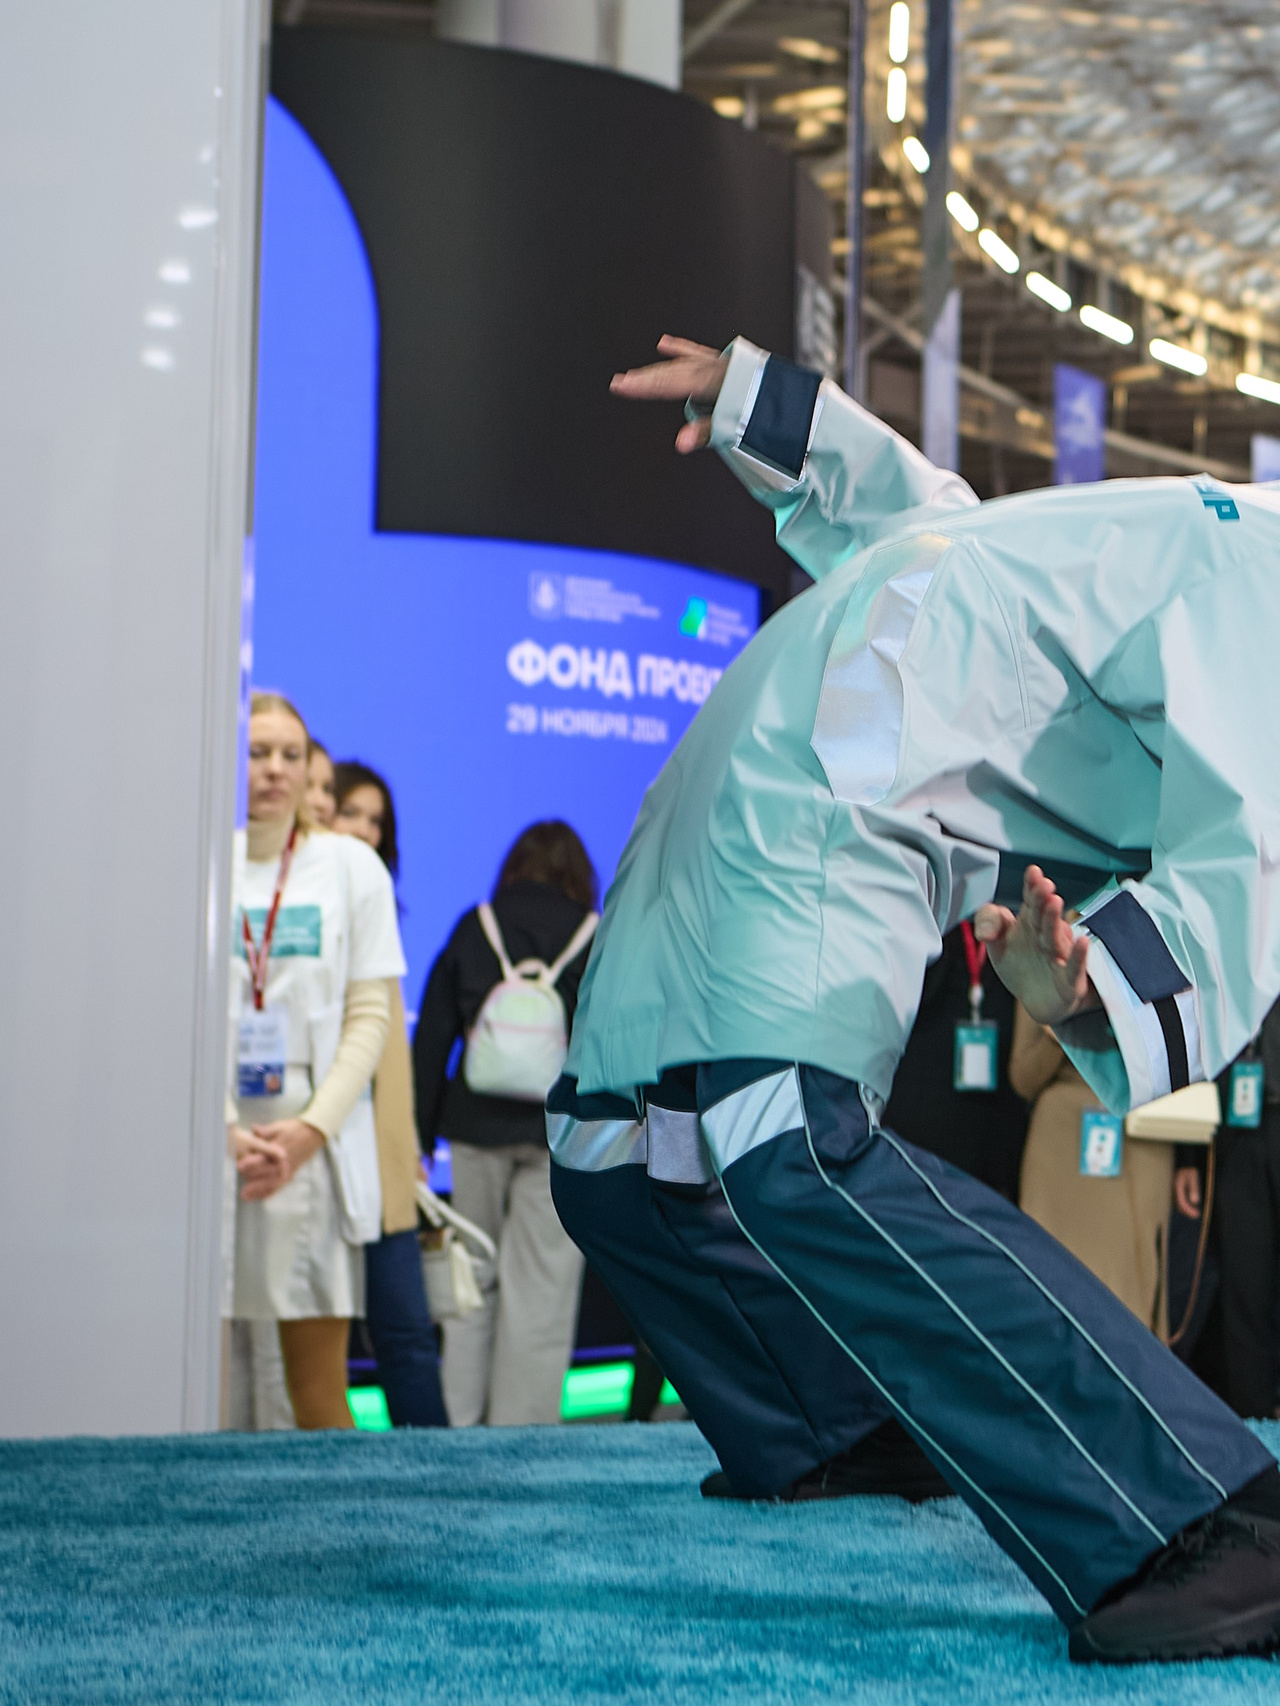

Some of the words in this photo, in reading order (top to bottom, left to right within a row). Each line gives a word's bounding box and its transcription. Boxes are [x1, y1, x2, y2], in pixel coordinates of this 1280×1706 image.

[507, 638, 635, 701] ФОНД
[505, 702, 537, 735] 29
[541, 706, 630, 740] НОЯБРЯ
